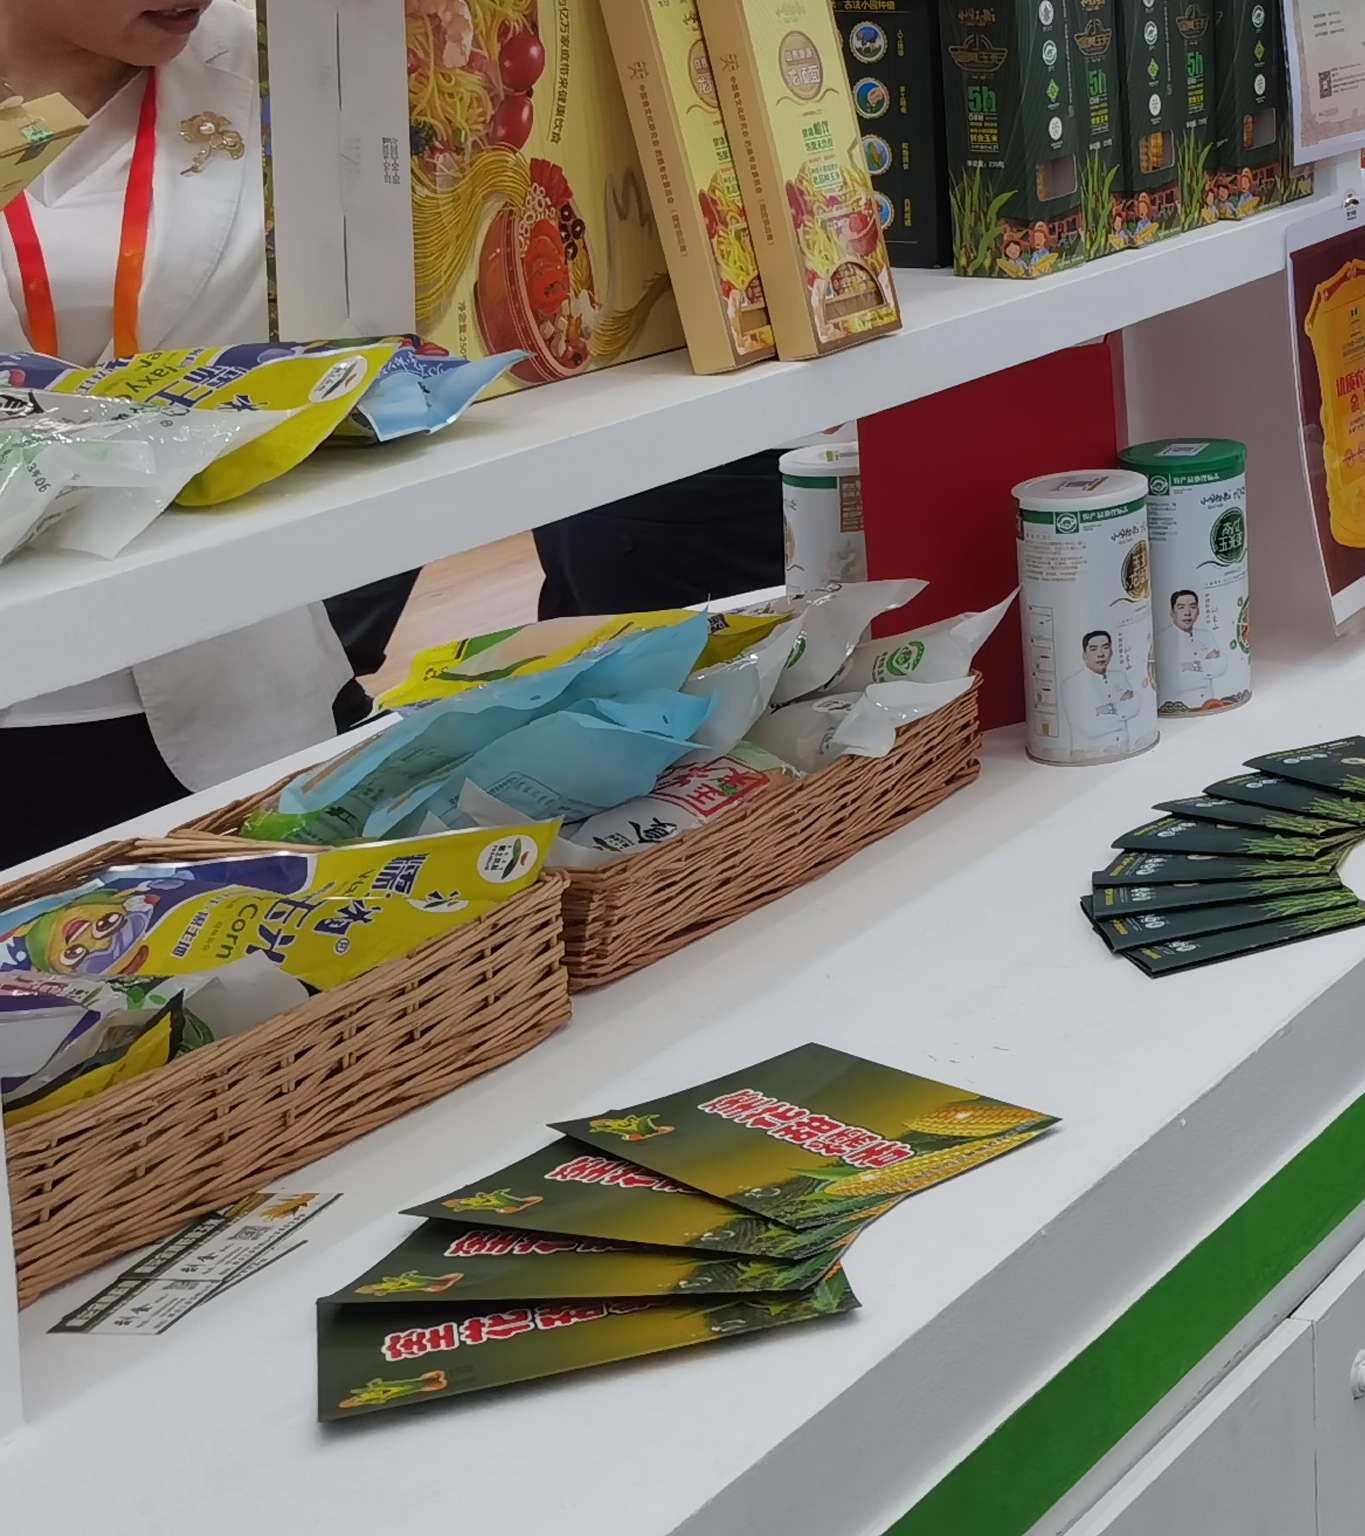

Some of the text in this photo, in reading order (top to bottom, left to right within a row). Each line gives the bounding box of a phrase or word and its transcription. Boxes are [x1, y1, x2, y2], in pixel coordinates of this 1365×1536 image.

[1187, 50, 1204, 77] 5h
[1088, 68, 1108, 96] 5h
[967, 86, 997, 113] 5h
[215, 901, 259, 961] Corn
